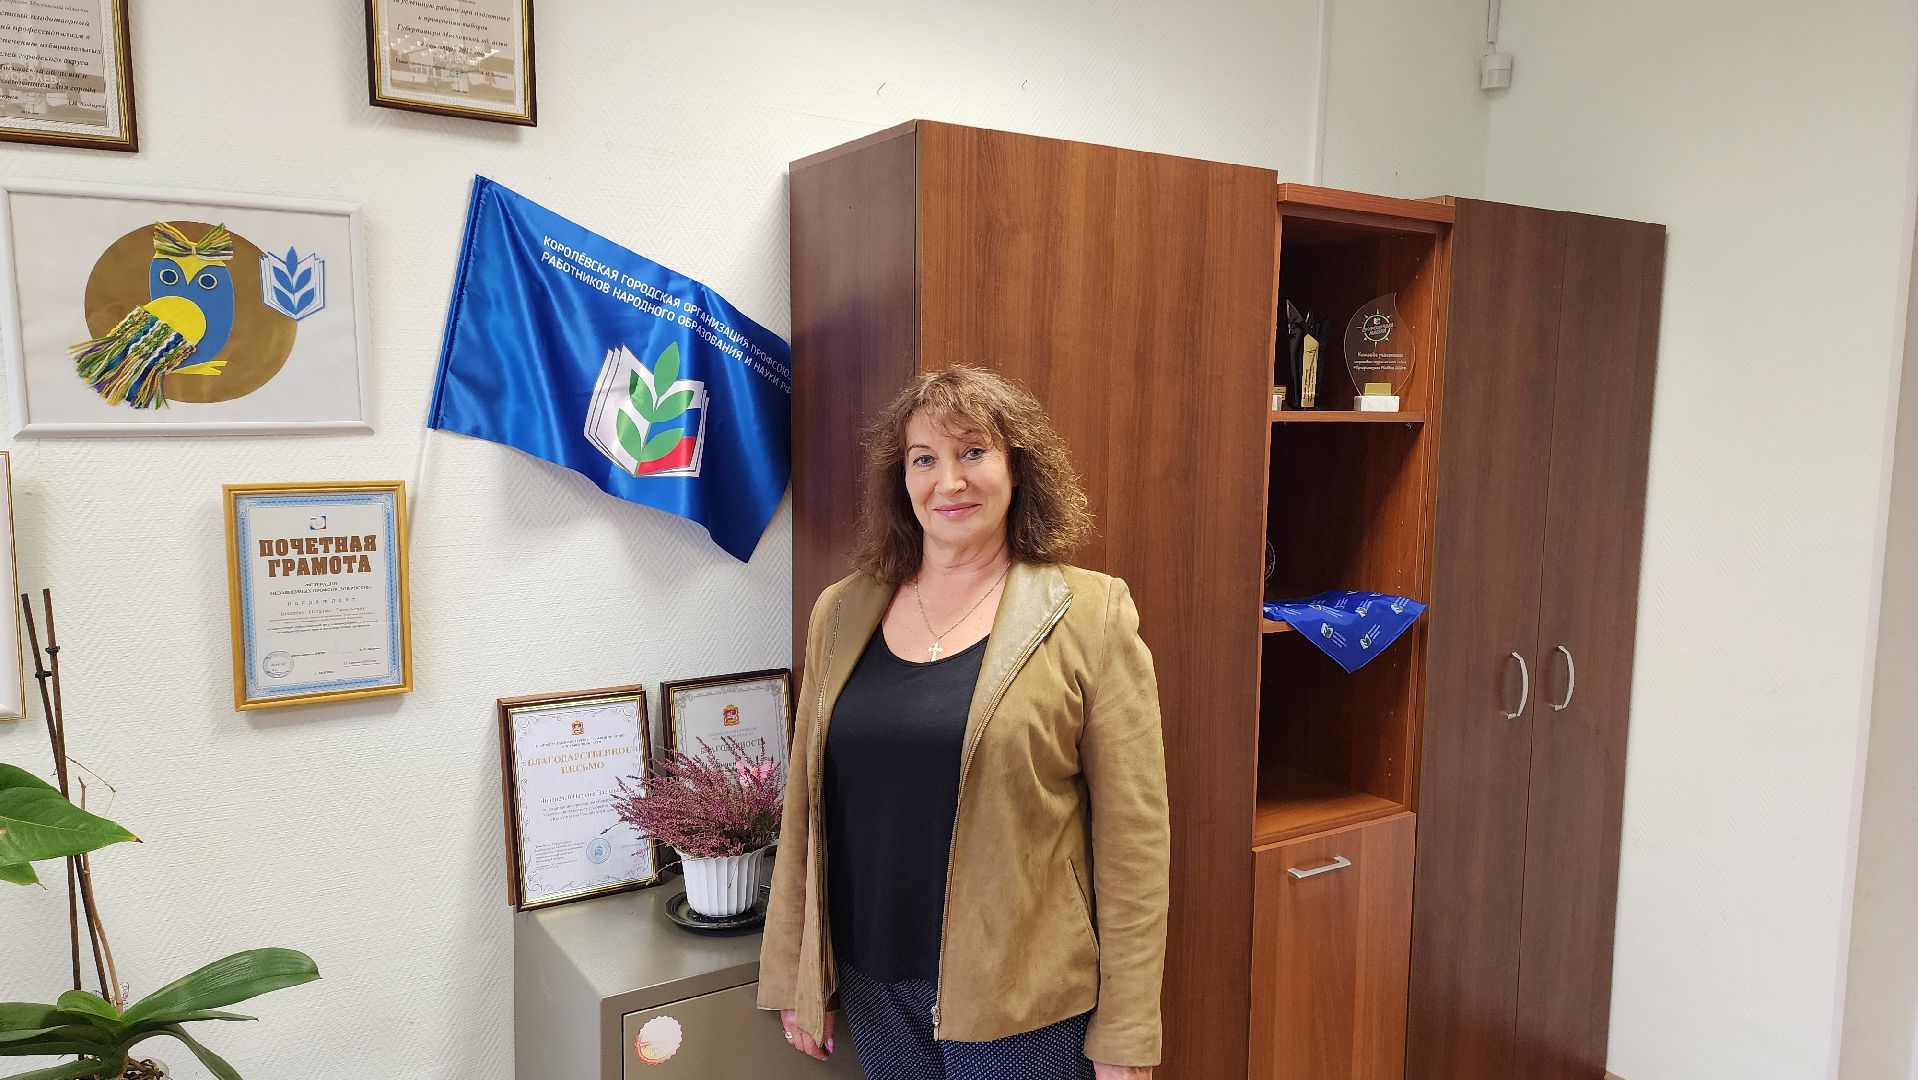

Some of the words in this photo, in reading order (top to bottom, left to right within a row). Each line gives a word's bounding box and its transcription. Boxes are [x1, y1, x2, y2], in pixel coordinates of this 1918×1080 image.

[541, 251, 610, 294] РАБОТНИКОВ
[612, 287, 675, 322] НАРОДНОГО
[677, 315, 744, 361] ОБРАЗОВАНИЯ
[744, 355, 752, 366] И
[753, 361, 780, 386] НАУКИ
[543, 235, 619, 279] КОРОЛЁВСКАЯ
[620, 275, 681, 308] ГОРОДСКАЯ
[683, 301, 750, 348] ОРГАНИЗАЦИЯ
[750, 343, 791, 380] ПРОФСОЮ
[258, 534, 377, 557] ПОЧЕТНАЯ
[267, 554, 372, 578] ГРАМОТА
[527, 746, 631, 767] БЛАГОДАРСТВЕННОЕ
[560, 761, 605, 775] ПИСЬМО
